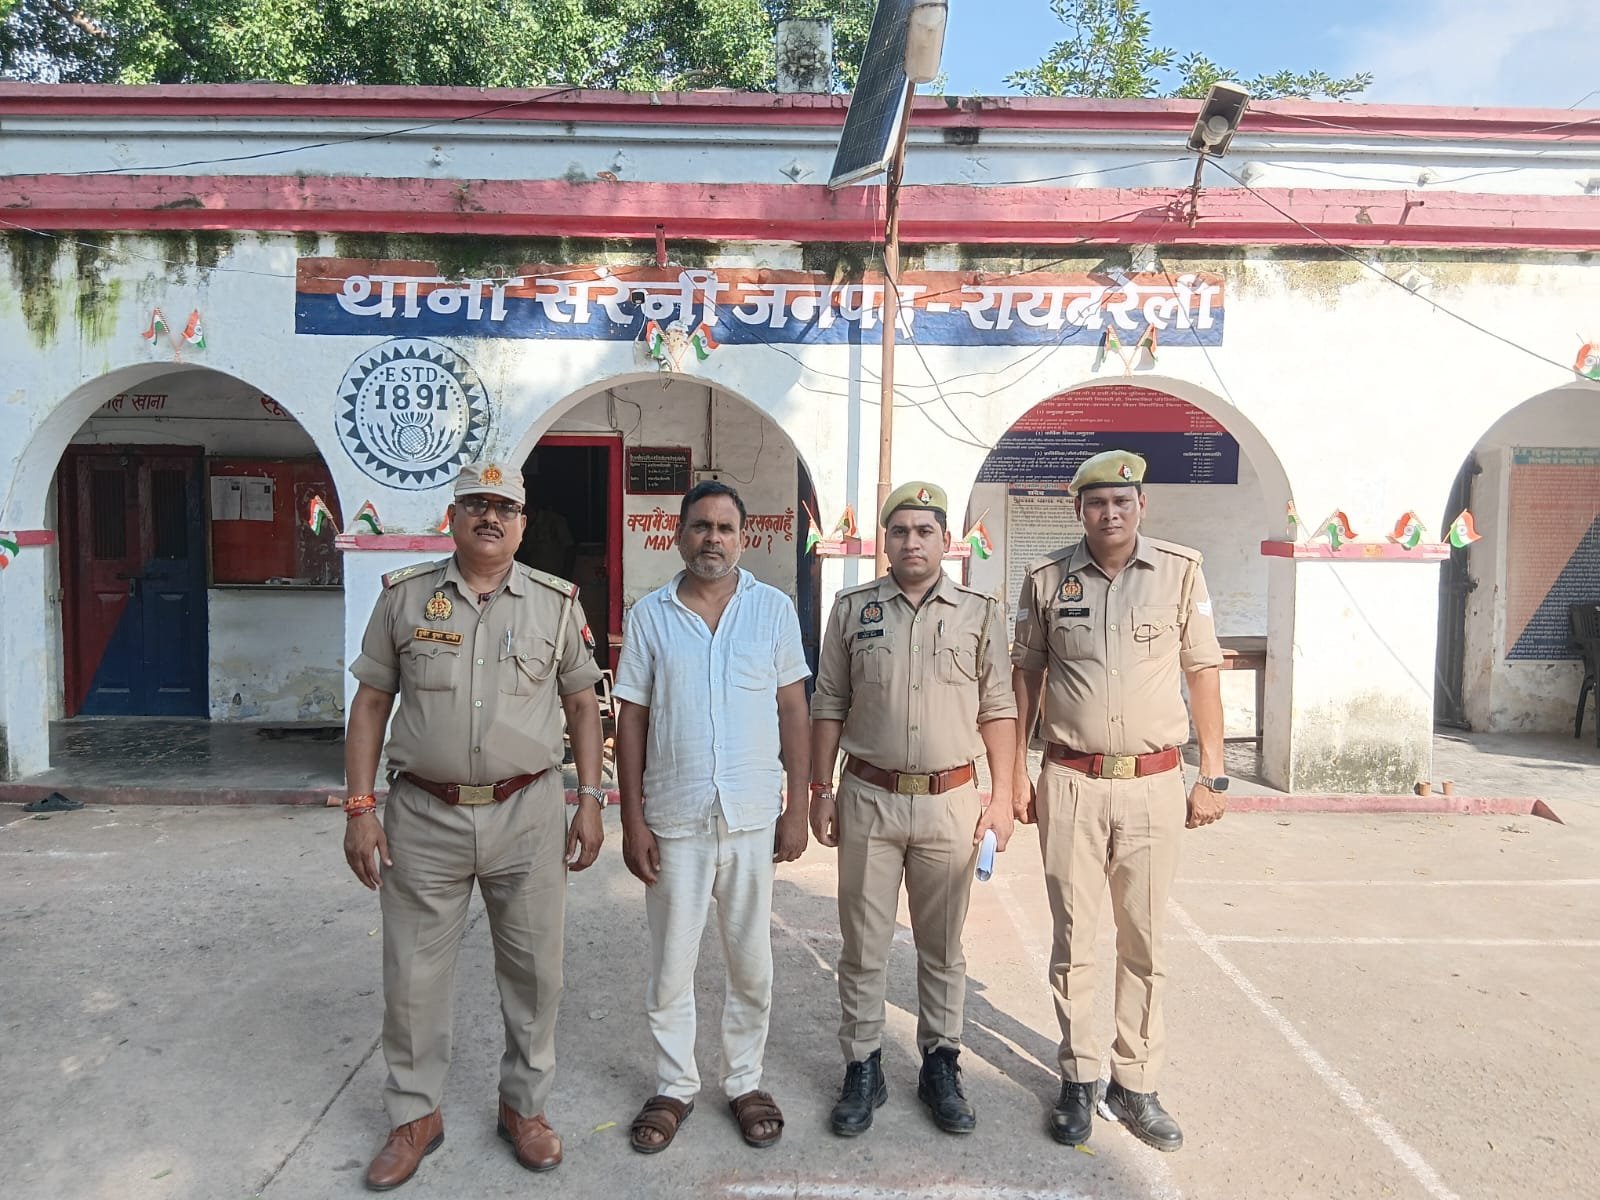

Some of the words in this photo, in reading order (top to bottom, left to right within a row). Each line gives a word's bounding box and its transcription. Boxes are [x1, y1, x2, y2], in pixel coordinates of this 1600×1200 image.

[336, 275, 525, 321] थाना
[535, 267, 730, 327] सरेनी
[131, 394, 169, 411] खाना
[375, 383, 448, 411] 1891
[644, 535, 675, 551] MAY
